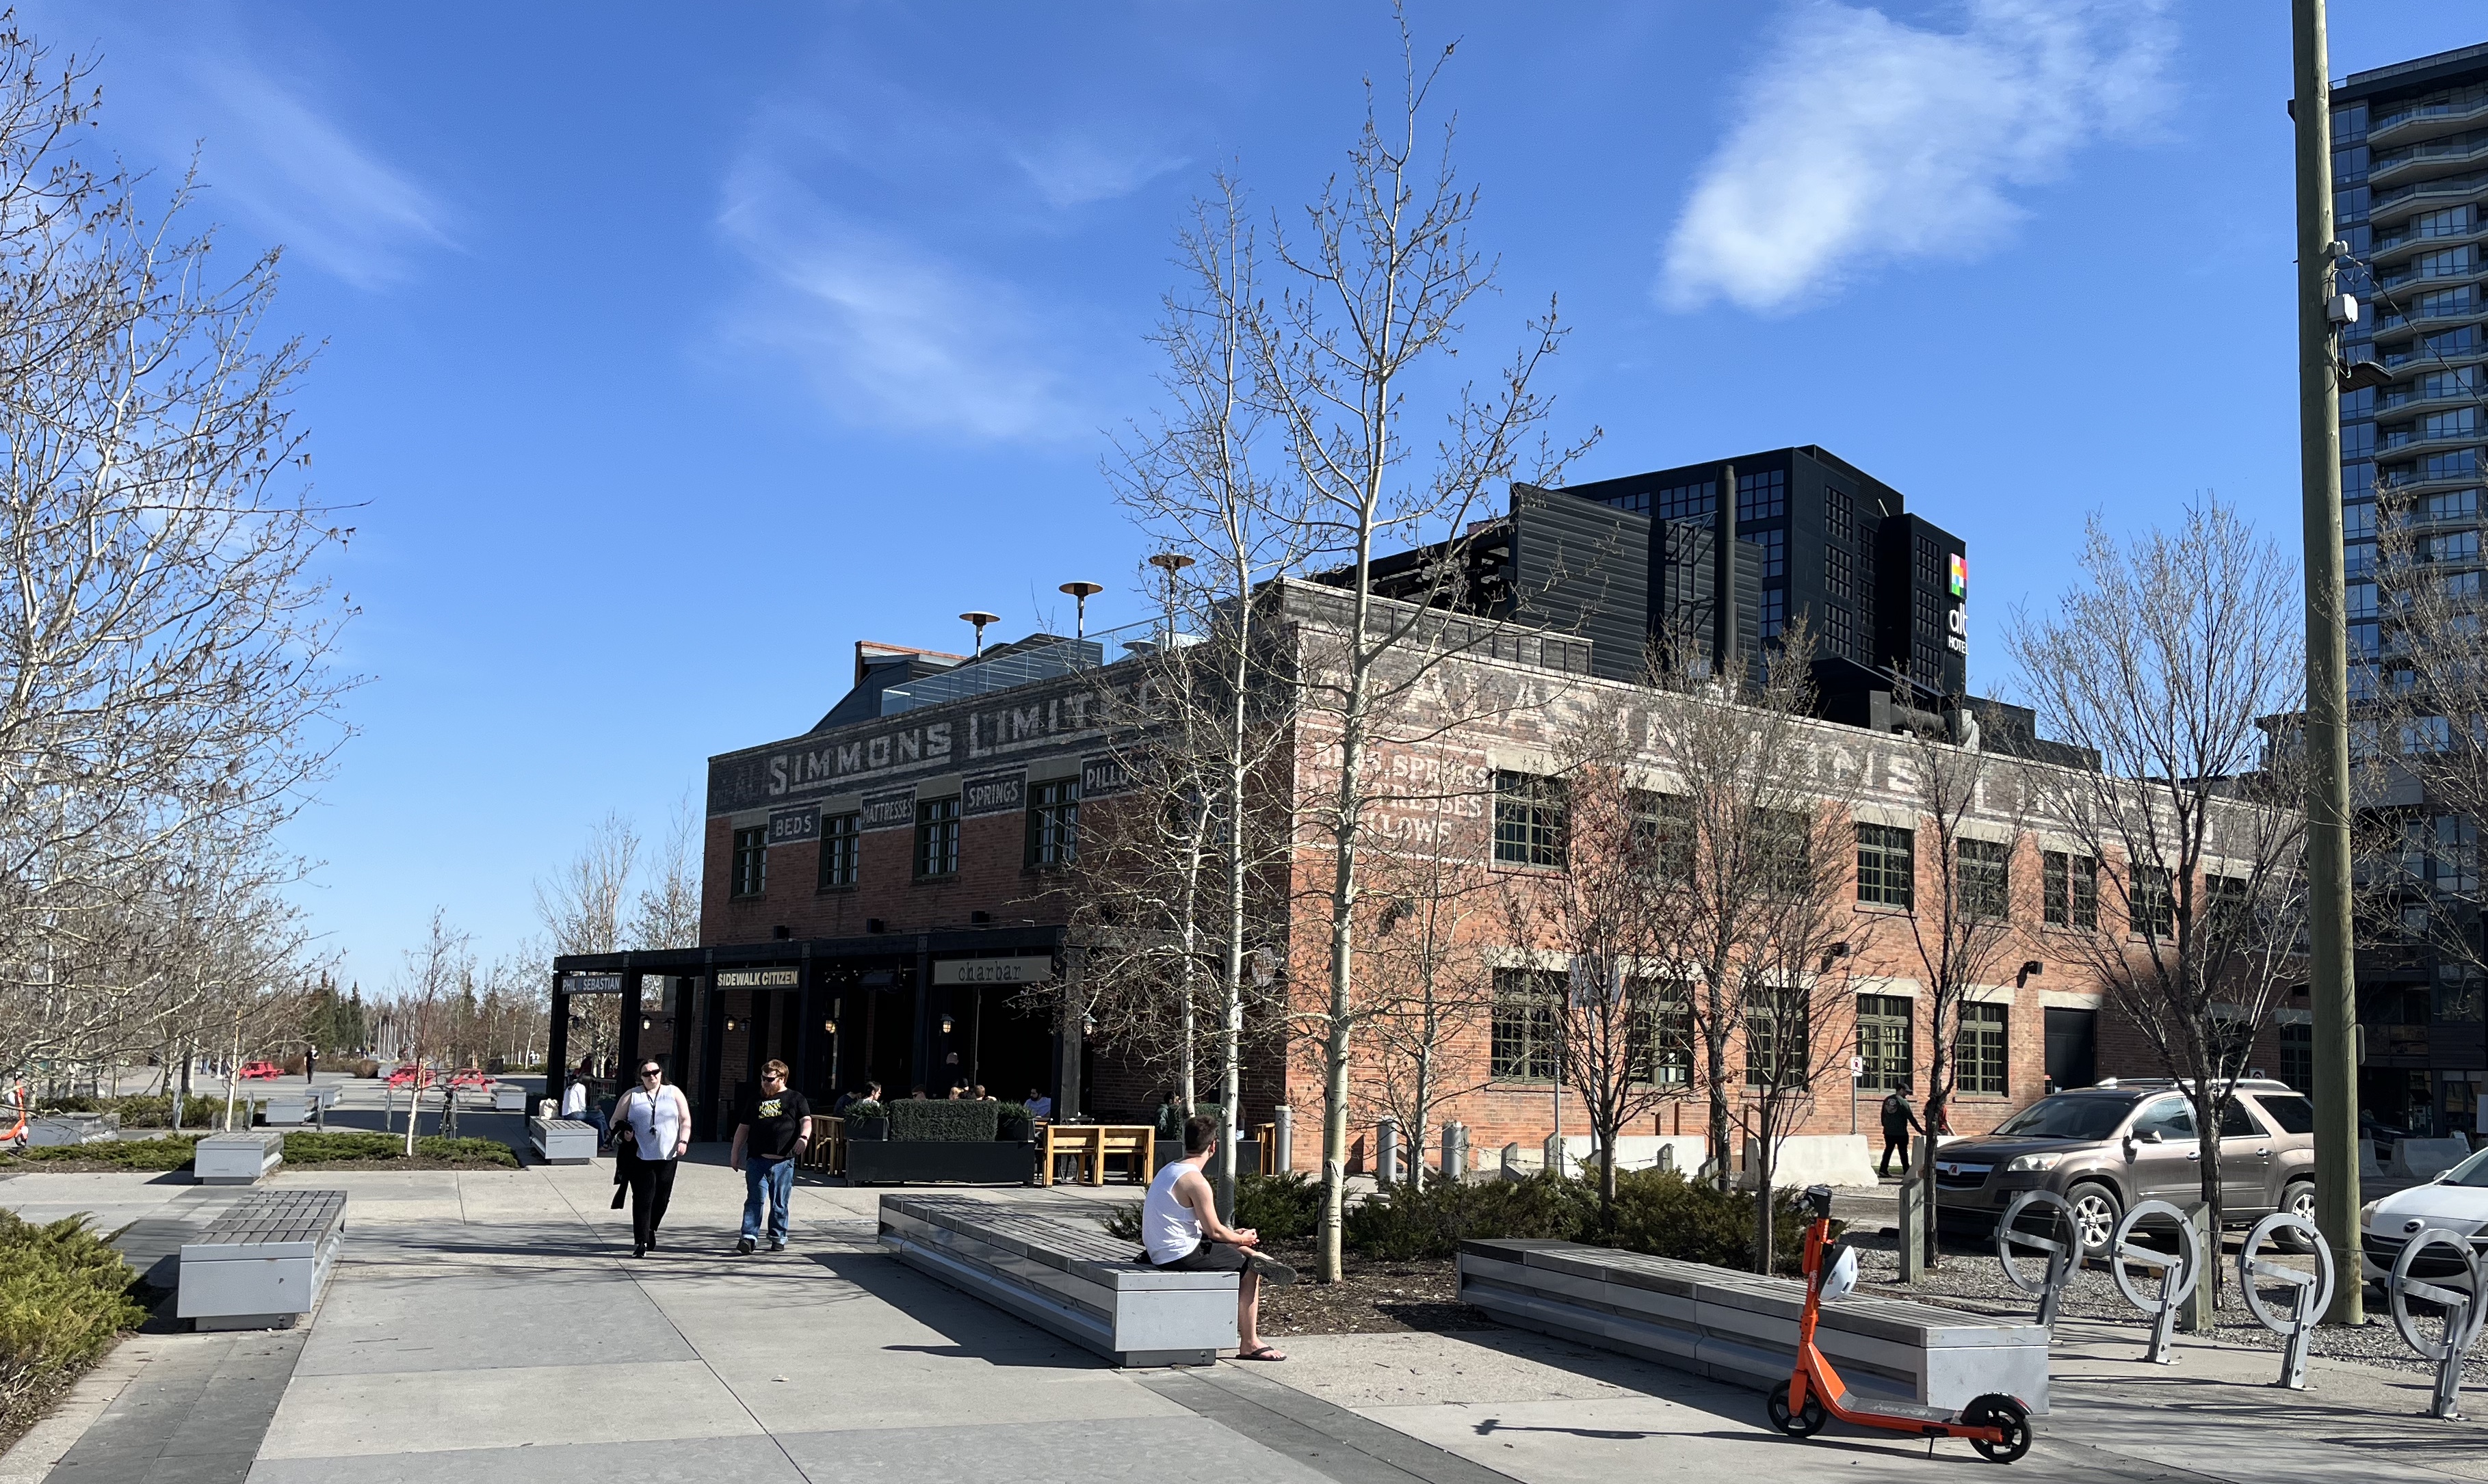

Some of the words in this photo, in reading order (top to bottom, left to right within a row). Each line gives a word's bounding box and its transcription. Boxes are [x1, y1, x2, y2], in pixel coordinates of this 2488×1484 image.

[1949, 602, 1968, 637] alt
[1948, 635, 1969, 655] HOTEL
[768, 721, 953, 797] SIMMONS
[968, 780, 1019, 808] SPRINGS
[862, 797, 913, 823] MATTRESSES
[775, 814, 812, 837] BEDS
[717, 972, 760, 987] SIDEWALK
[761, 970, 798, 985] CITIZEN
[958, 961, 1022, 982] charbar
[562, 979, 576, 991] PHIL
[583, 977, 620, 991] SEBASTIAN
